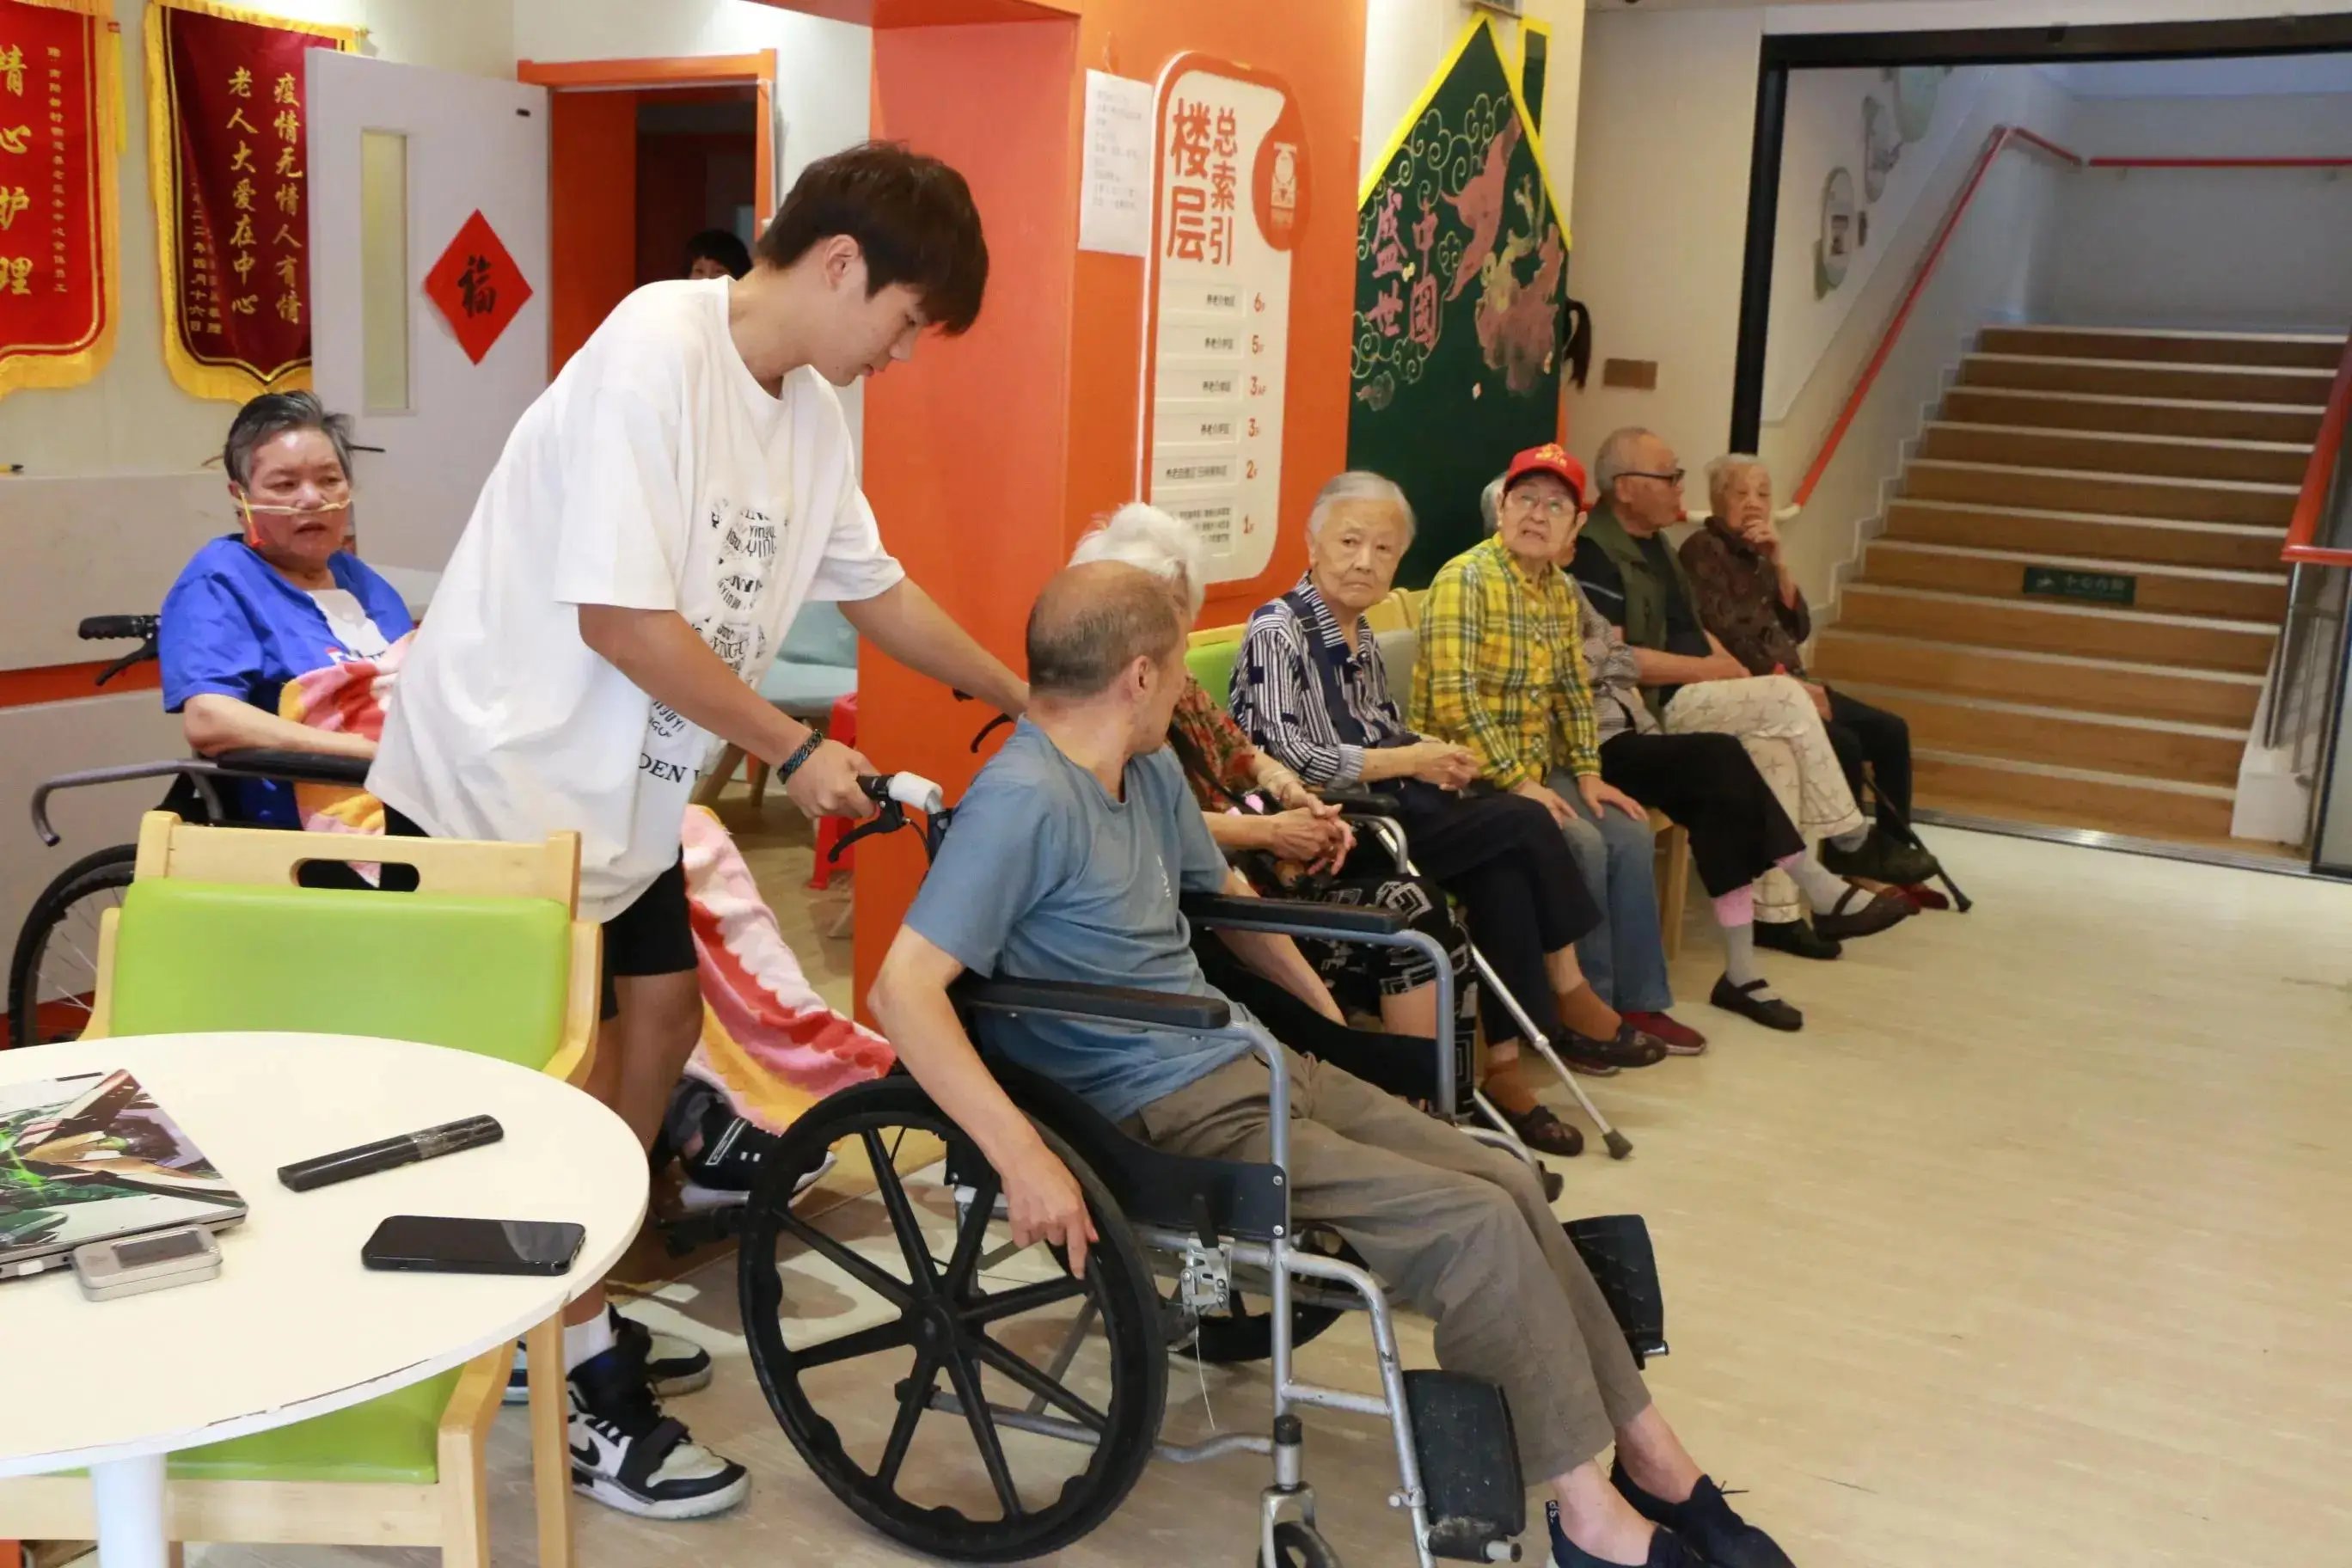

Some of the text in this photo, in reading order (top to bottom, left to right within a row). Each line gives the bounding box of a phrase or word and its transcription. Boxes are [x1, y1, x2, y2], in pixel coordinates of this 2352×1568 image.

[226, 66, 260, 315] 老人大爱在中心
[273, 72, 303, 325] 疫情无情人有情
[1167, 97, 1211, 262] 楼层
[1210, 106, 1238, 266] 总索引
[457, 255, 497, 319] 福
[1364, 187, 1408, 337] 盛世
